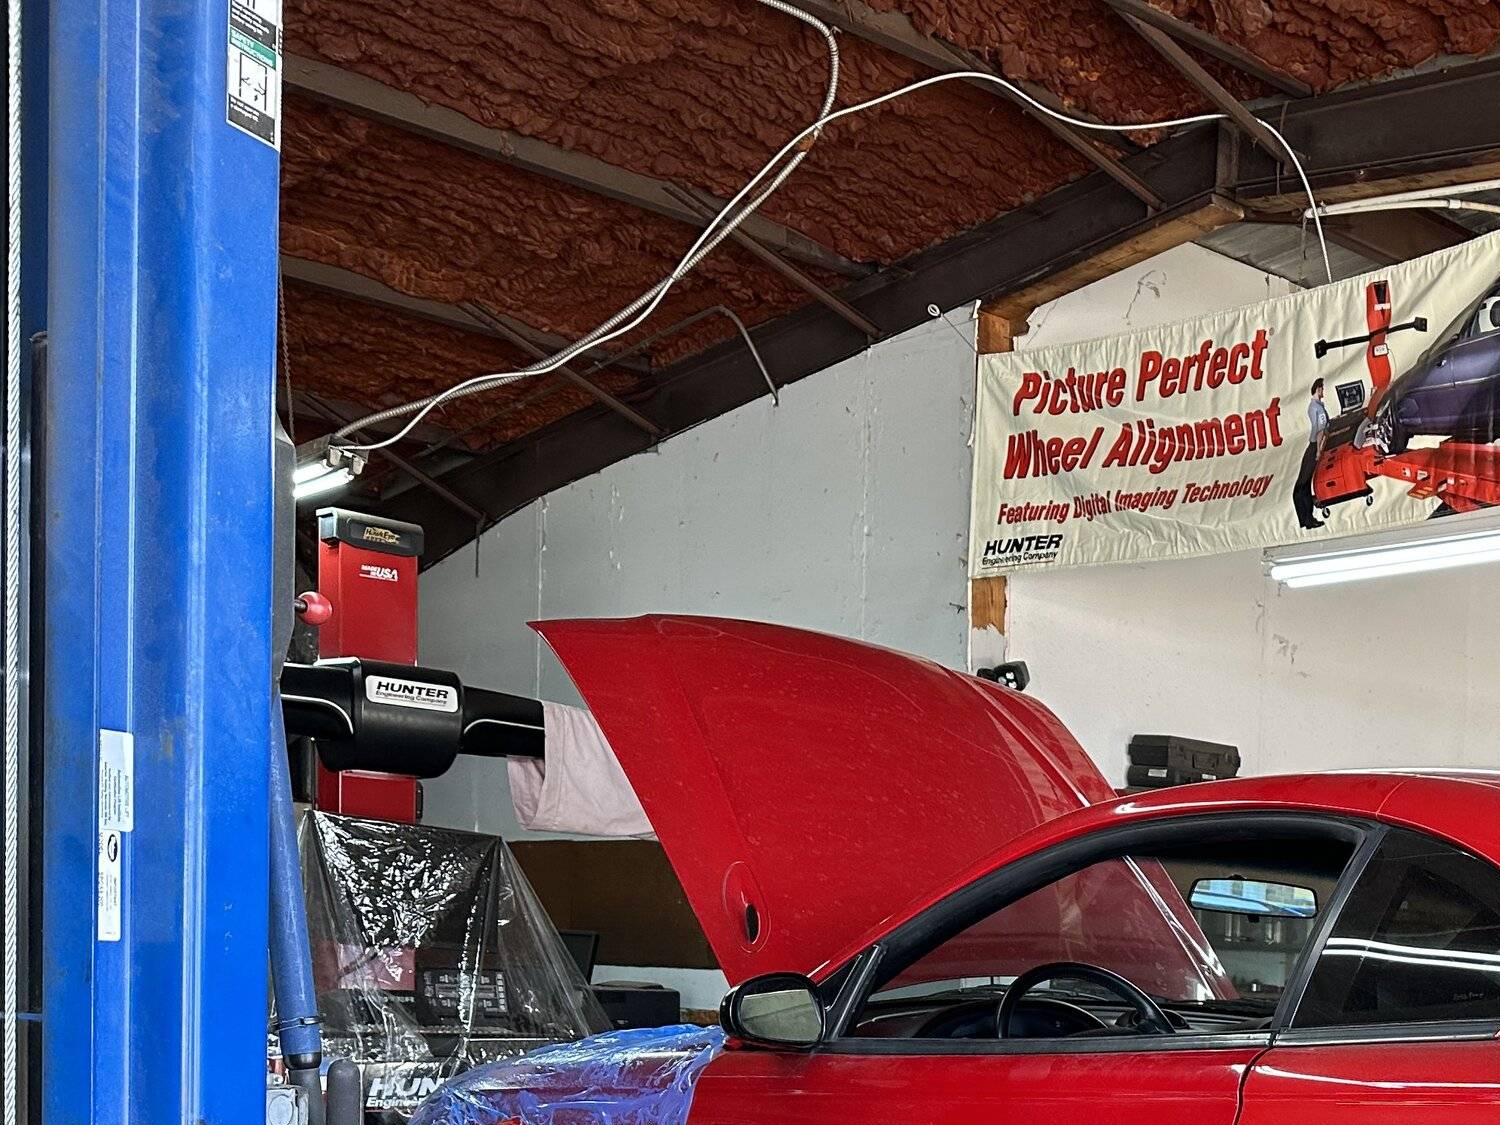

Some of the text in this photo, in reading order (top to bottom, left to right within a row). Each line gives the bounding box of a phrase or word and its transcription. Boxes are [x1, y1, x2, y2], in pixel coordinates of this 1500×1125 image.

[1012, 328, 1268, 416] Picture Perfect
[1003, 397, 1283, 480] Wheel Alignment
[997, 473, 1274, 525] Featuring Digital Imaging Technology
[984, 534, 1063, 556] HUNTER
[1023, 551, 1058, 561] Company
[377, 681, 449, 699] HUNTER
[369, 1077, 450, 1096] HUN
